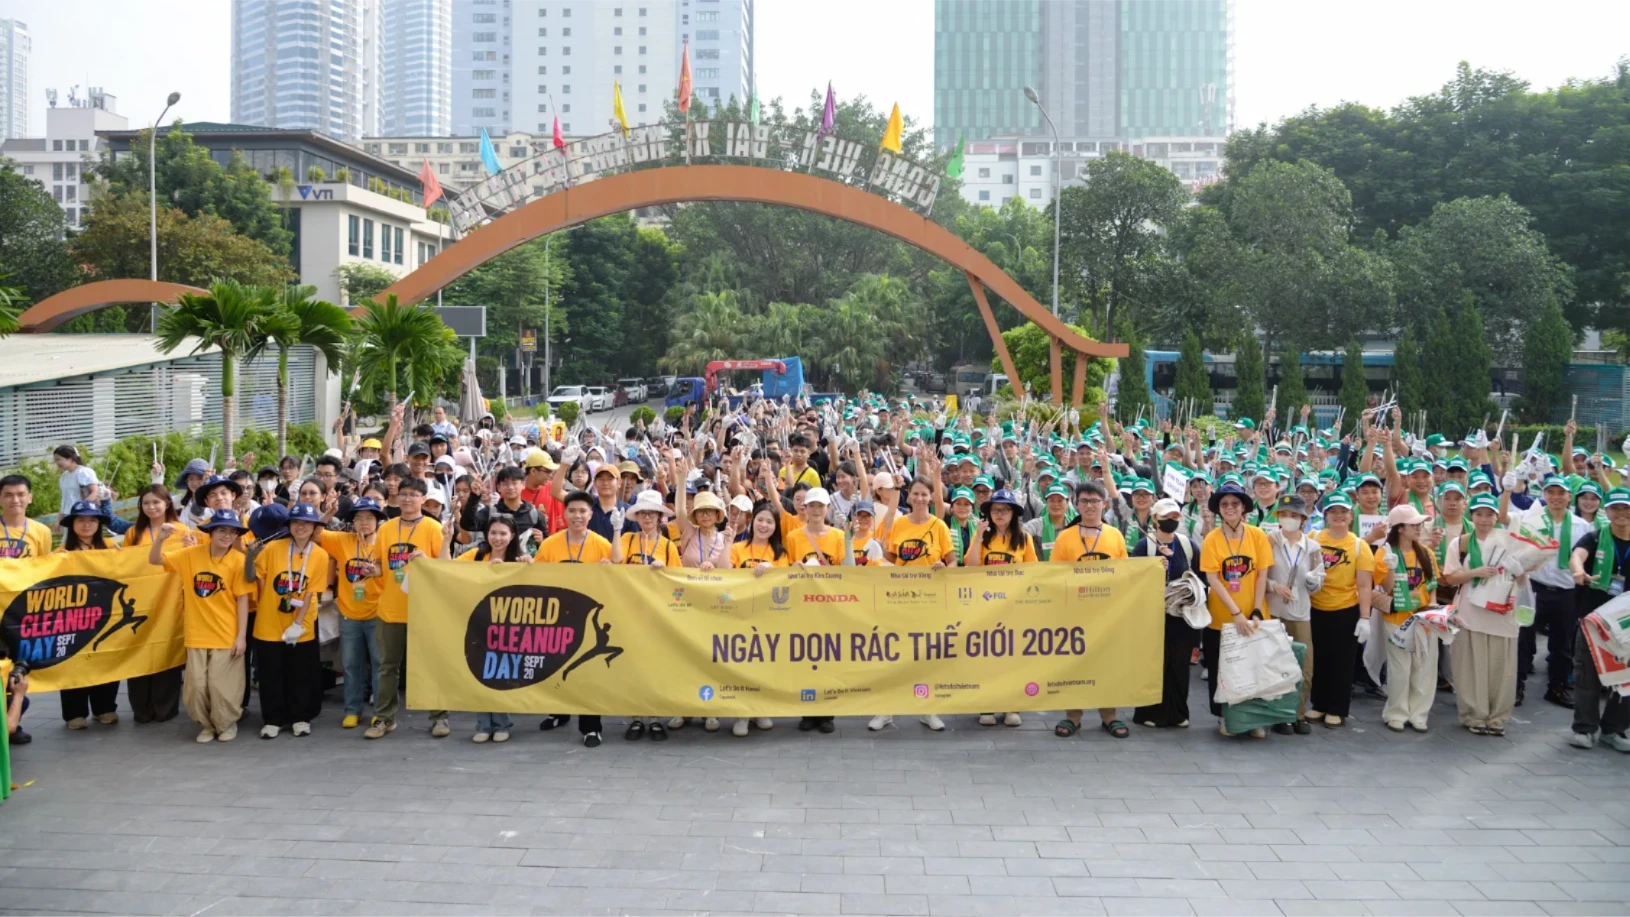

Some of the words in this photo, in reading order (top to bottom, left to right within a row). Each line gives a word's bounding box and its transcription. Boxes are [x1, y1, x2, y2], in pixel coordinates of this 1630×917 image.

[312, 189, 334, 200] VTI
[993, 592, 1007, 600] FGL
[1085, 585, 1111, 593] Hilton
[27, 583, 89, 614] WORLD
[803, 594, 860, 603] HONDA
[490, 597, 560, 625] WORLD
[20, 606, 103, 638] CLEANUP
[56, 633, 77, 646] SEPT
[487, 625, 574, 655] CLEANUP
[712, 626, 781, 663] NGÀY
[789, 633, 842, 671] DỌN
[851, 625, 901, 662] RÁC
[908, 620, 962, 661] THẾ
[965, 621, 1014, 658] GIỚI
[1022, 626, 1087, 657] 2026
[18, 636, 56, 662] DAY
[56, 646, 67, 658] 20
[482, 652, 523, 680] DAY
[524, 655, 545, 669] SEPT
[523, 668, 535, 680] 20
